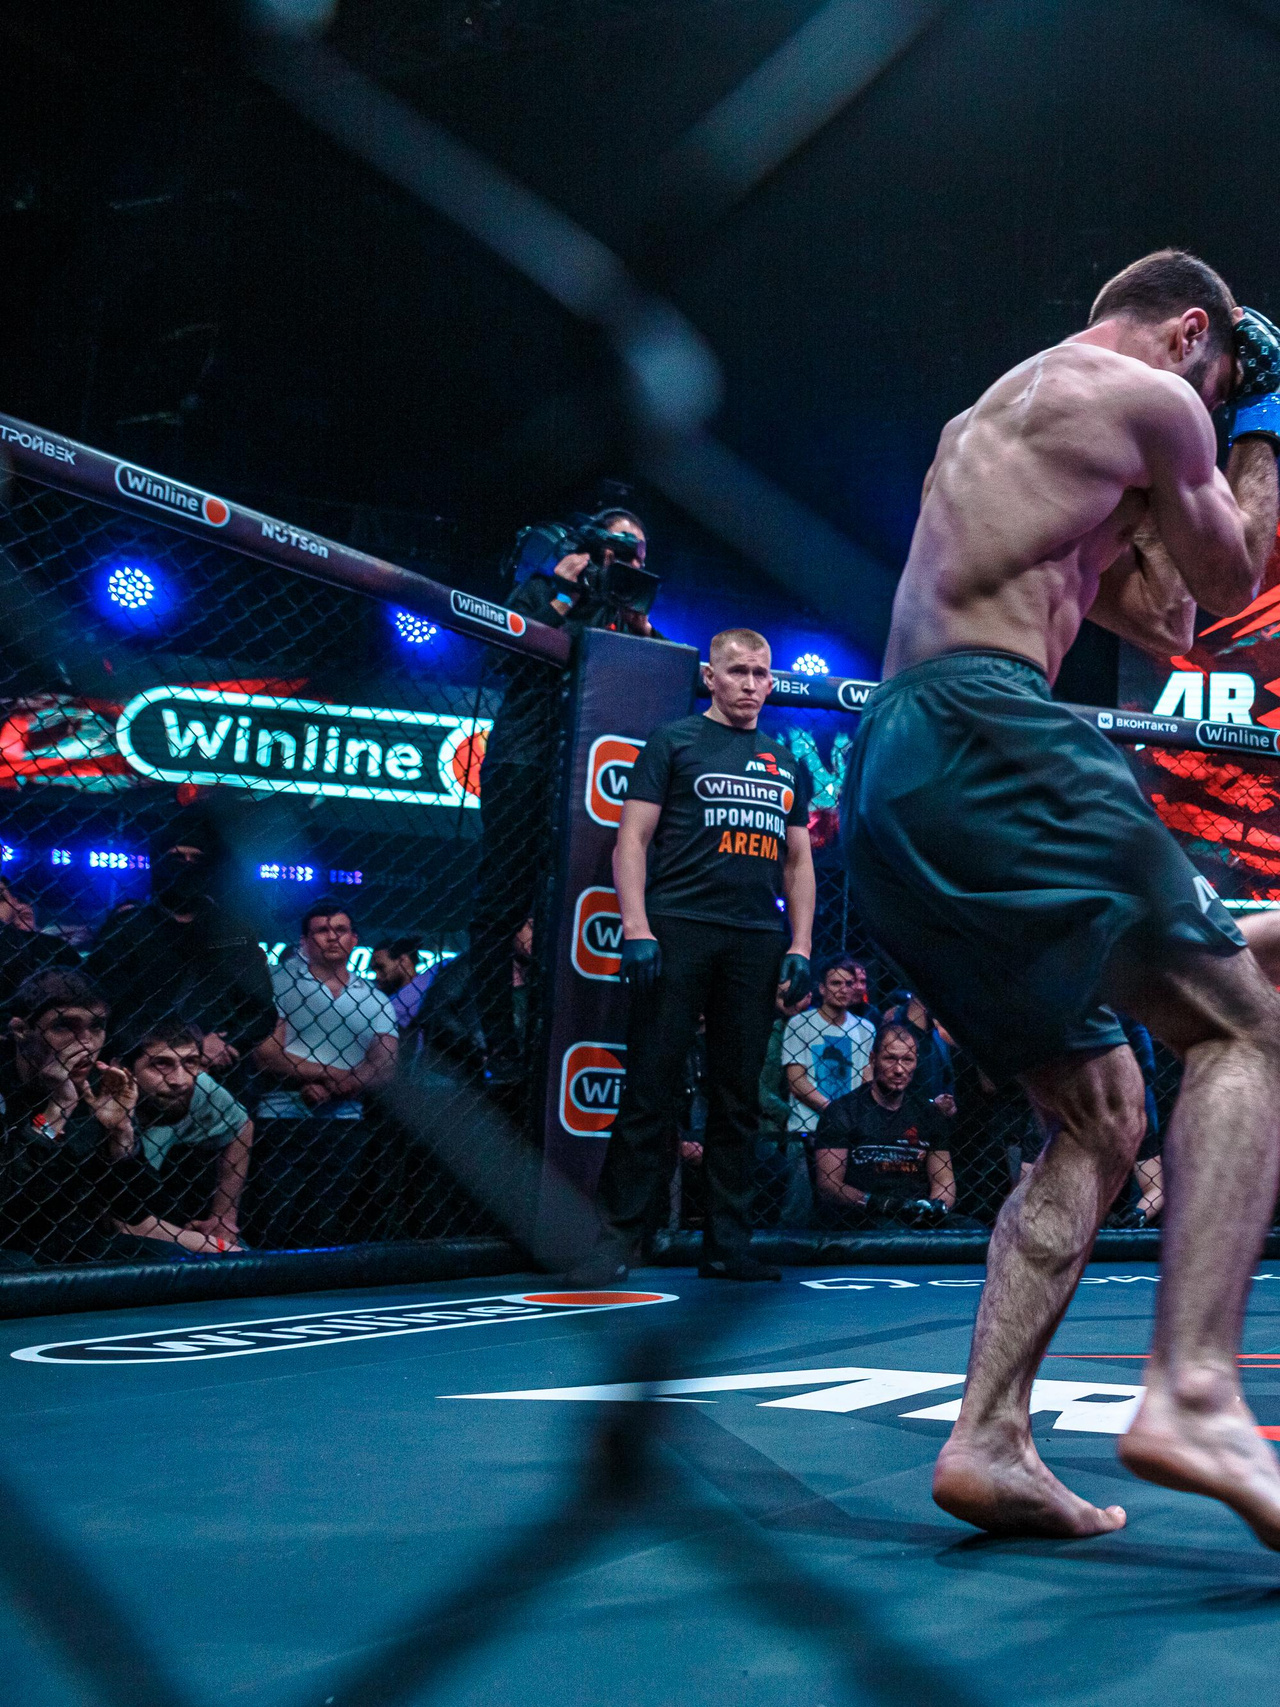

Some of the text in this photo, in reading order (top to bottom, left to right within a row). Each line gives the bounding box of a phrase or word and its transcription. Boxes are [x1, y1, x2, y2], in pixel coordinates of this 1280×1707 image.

[0, 426, 76, 466] ТРОЙВЕК
[127, 471, 199, 512] Winline
[457, 595, 505, 625] Winline
[161, 708, 424, 781] Winline
[1206, 726, 1270, 748] Winline
[705, 780, 778, 801] Winline
[705, 808, 786, 841] ПРОМОКОД
[718, 831, 778, 861] ARENA
[582, 1076, 626, 1105] Wi
[85, 1304, 543, 1353] Winline
